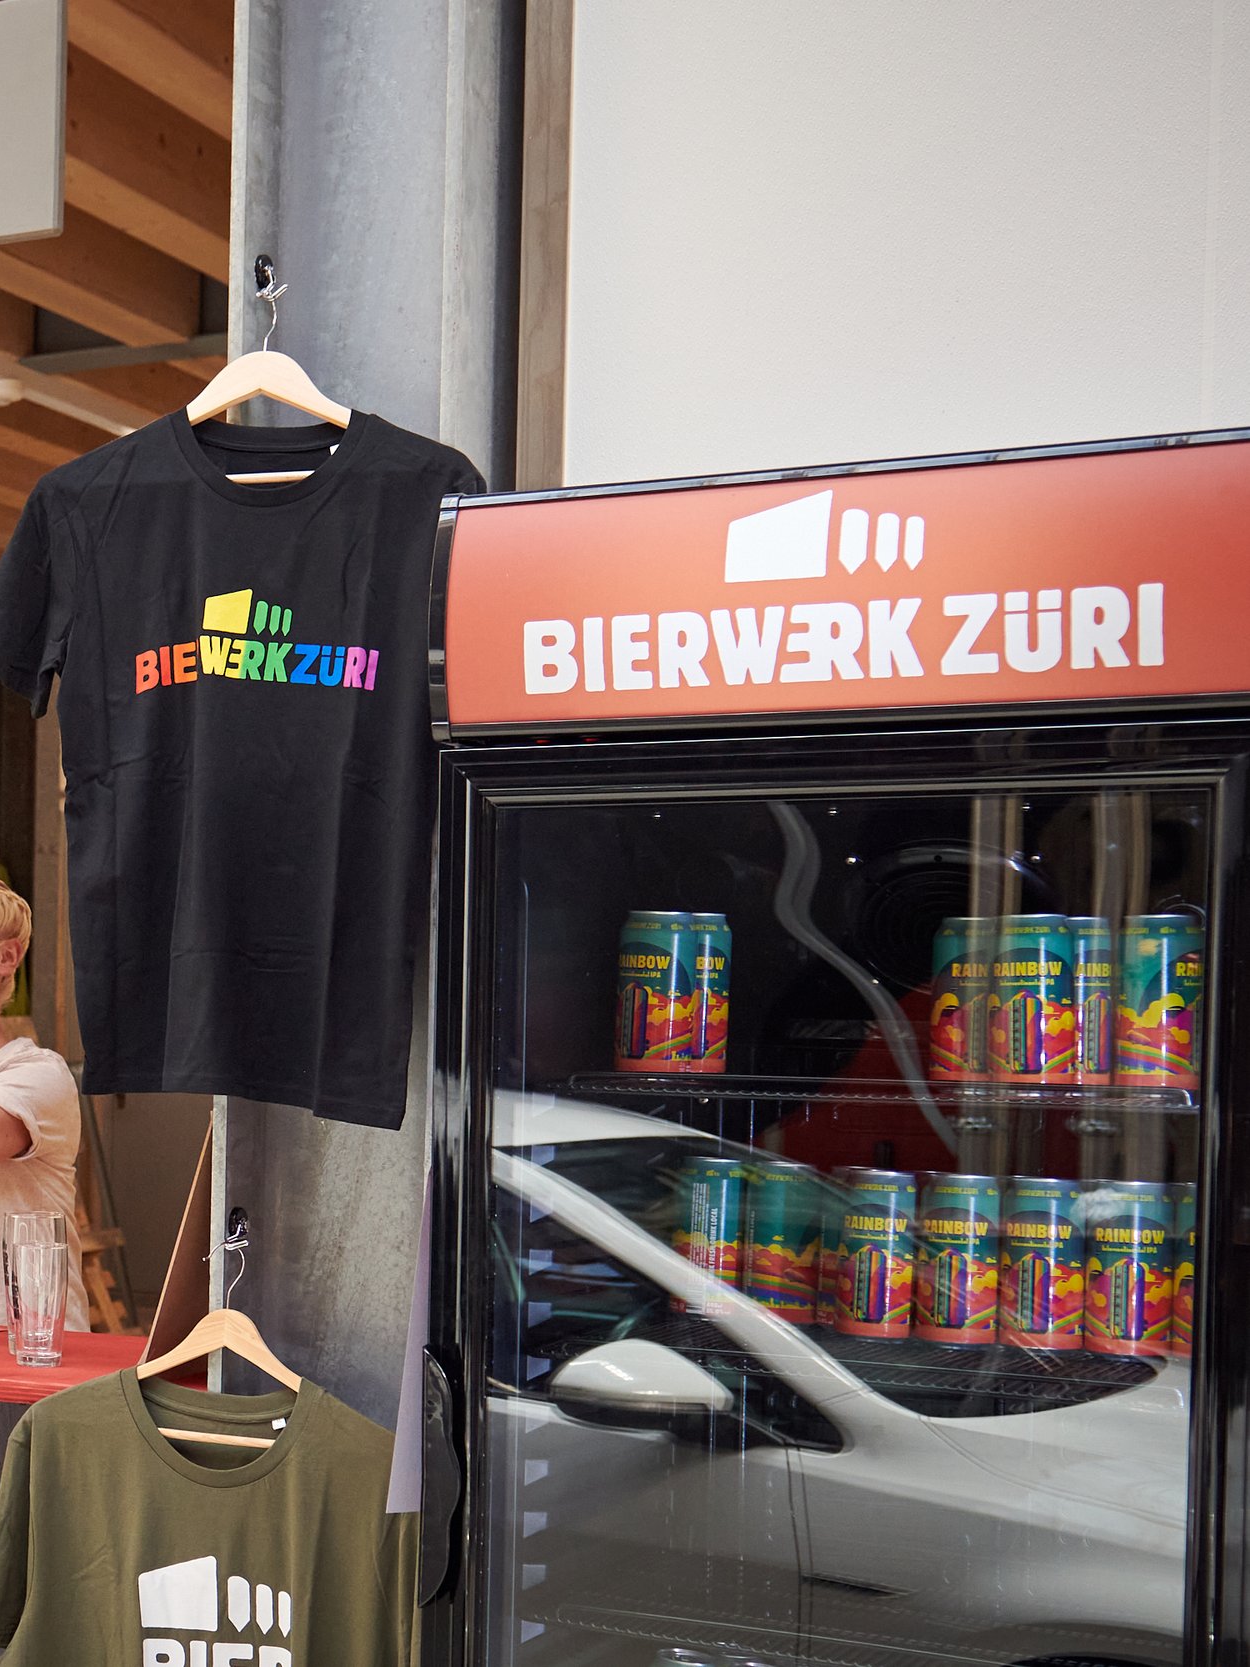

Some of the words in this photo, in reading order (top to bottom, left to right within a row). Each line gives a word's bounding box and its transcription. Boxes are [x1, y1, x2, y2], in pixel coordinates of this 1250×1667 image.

[940, 582, 1165, 676] ZÜRI
[289, 642, 380, 691] ZÜRI
[994, 961, 1063, 977] RAINBOW
[844, 1215, 908, 1233] RAINBOW
[924, 1219, 989, 1236] RAINBOW
[1006, 1222, 1072, 1241] RAINBOW
[1095, 1227, 1165, 1245] RAINBOW
